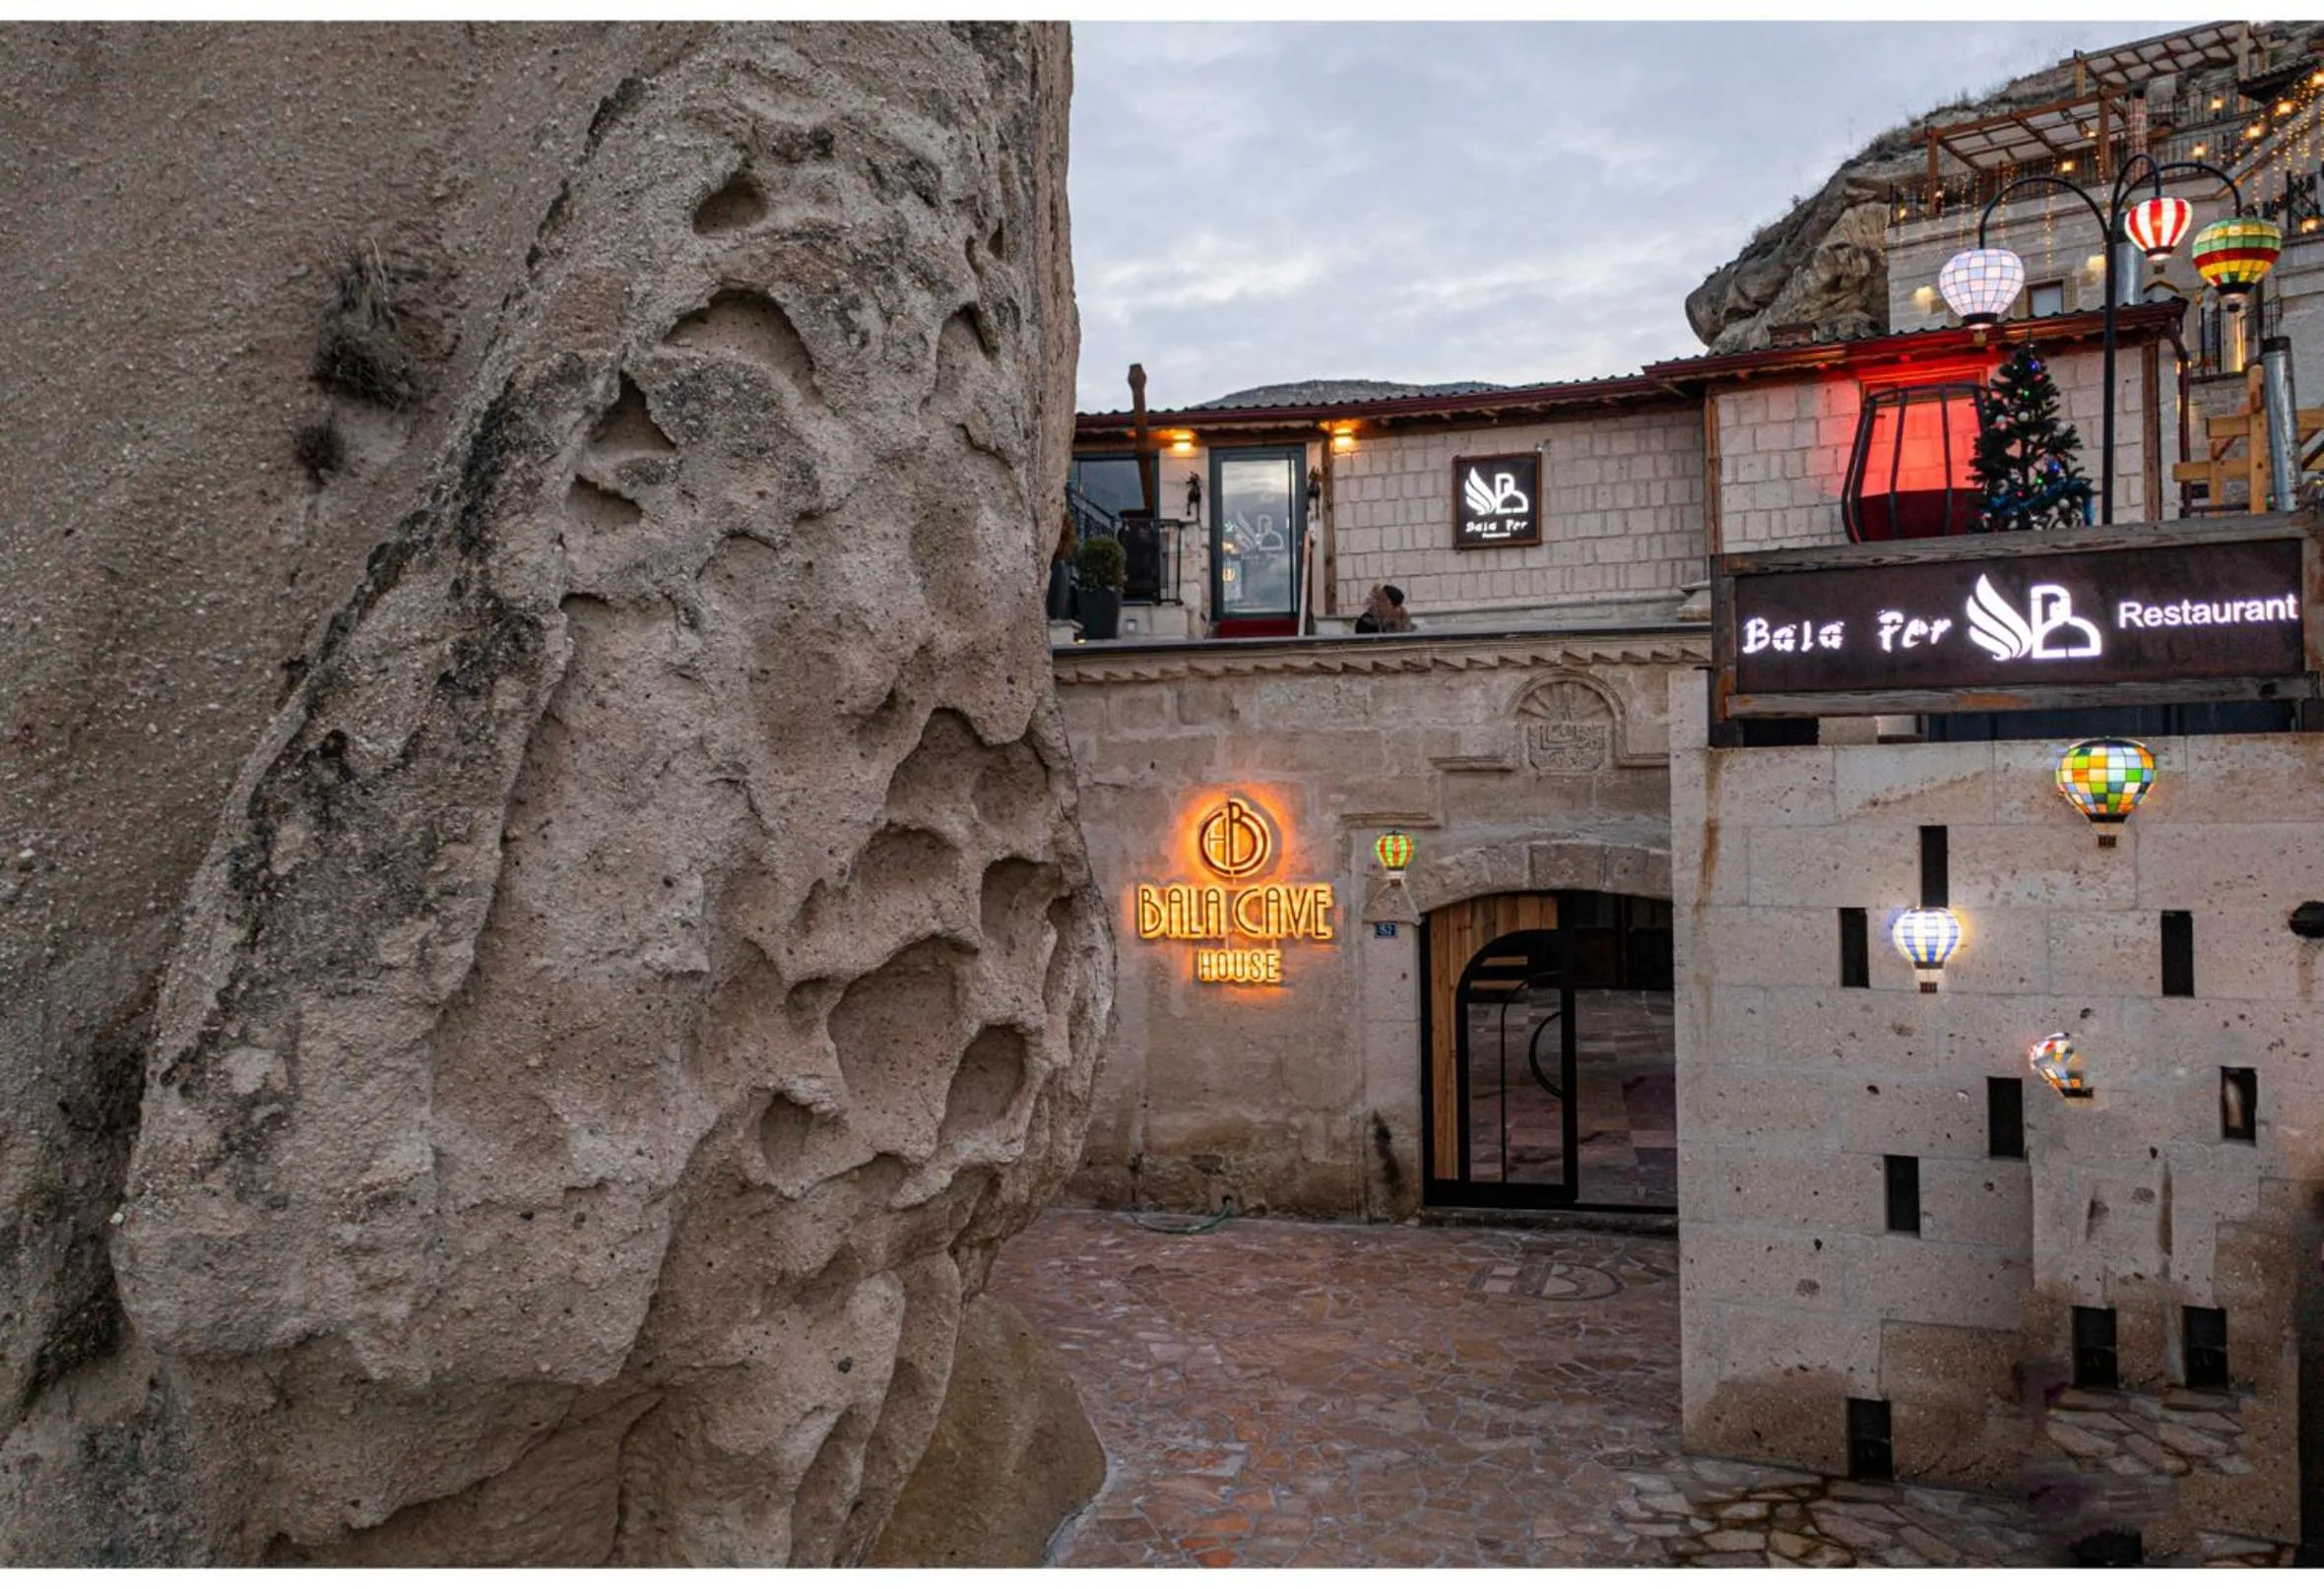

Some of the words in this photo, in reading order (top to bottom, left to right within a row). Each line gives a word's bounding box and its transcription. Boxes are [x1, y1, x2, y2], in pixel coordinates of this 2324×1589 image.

[1742, 616, 1845, 655] Bala
[1876, 608, 1953, 653] Per
[2118, 593, 2299, 630] Restaurant
[1139, 884, 1227, 938] BALA
[1233, 884, 1333, 939] CAVE
[1198, 949, 1283, 983] HOUSE
